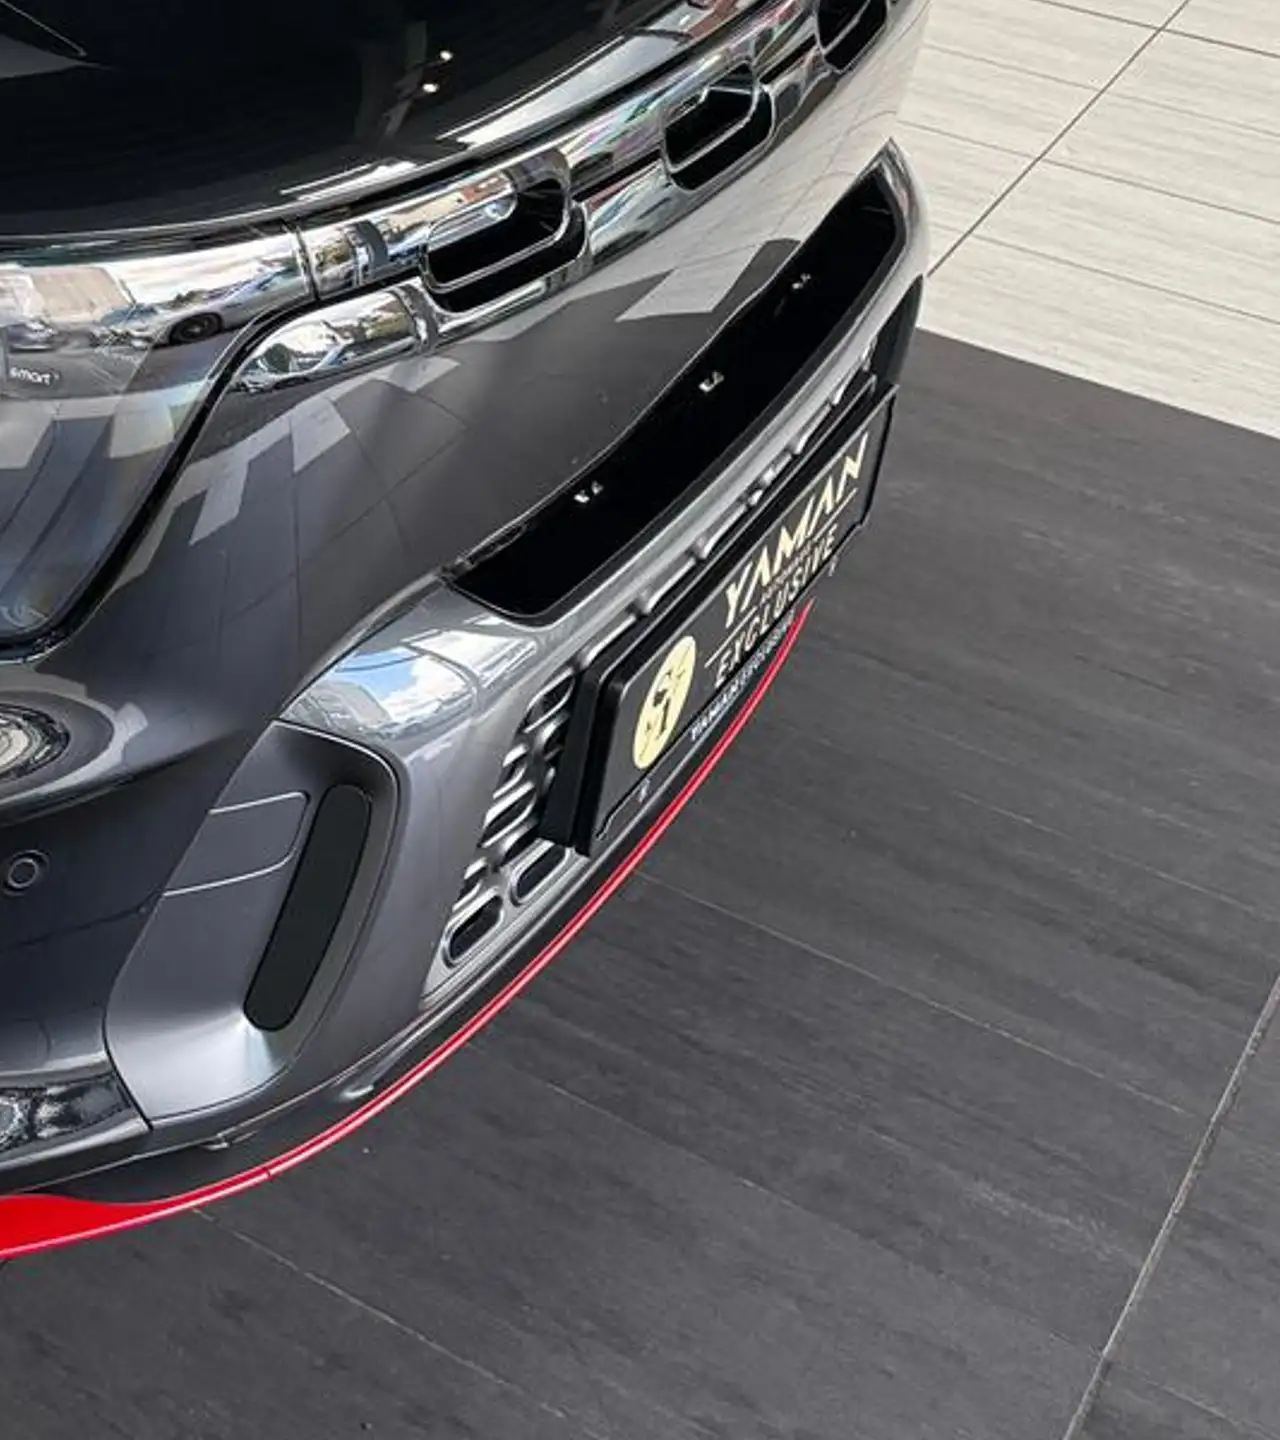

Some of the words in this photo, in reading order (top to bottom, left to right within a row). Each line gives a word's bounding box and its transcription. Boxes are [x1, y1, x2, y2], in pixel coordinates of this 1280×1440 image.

[10, 367, 51, 386] smart
[715, 523, 837, 688] EXCLUSIVE
[726, 432, 869, 629] YAMAN
